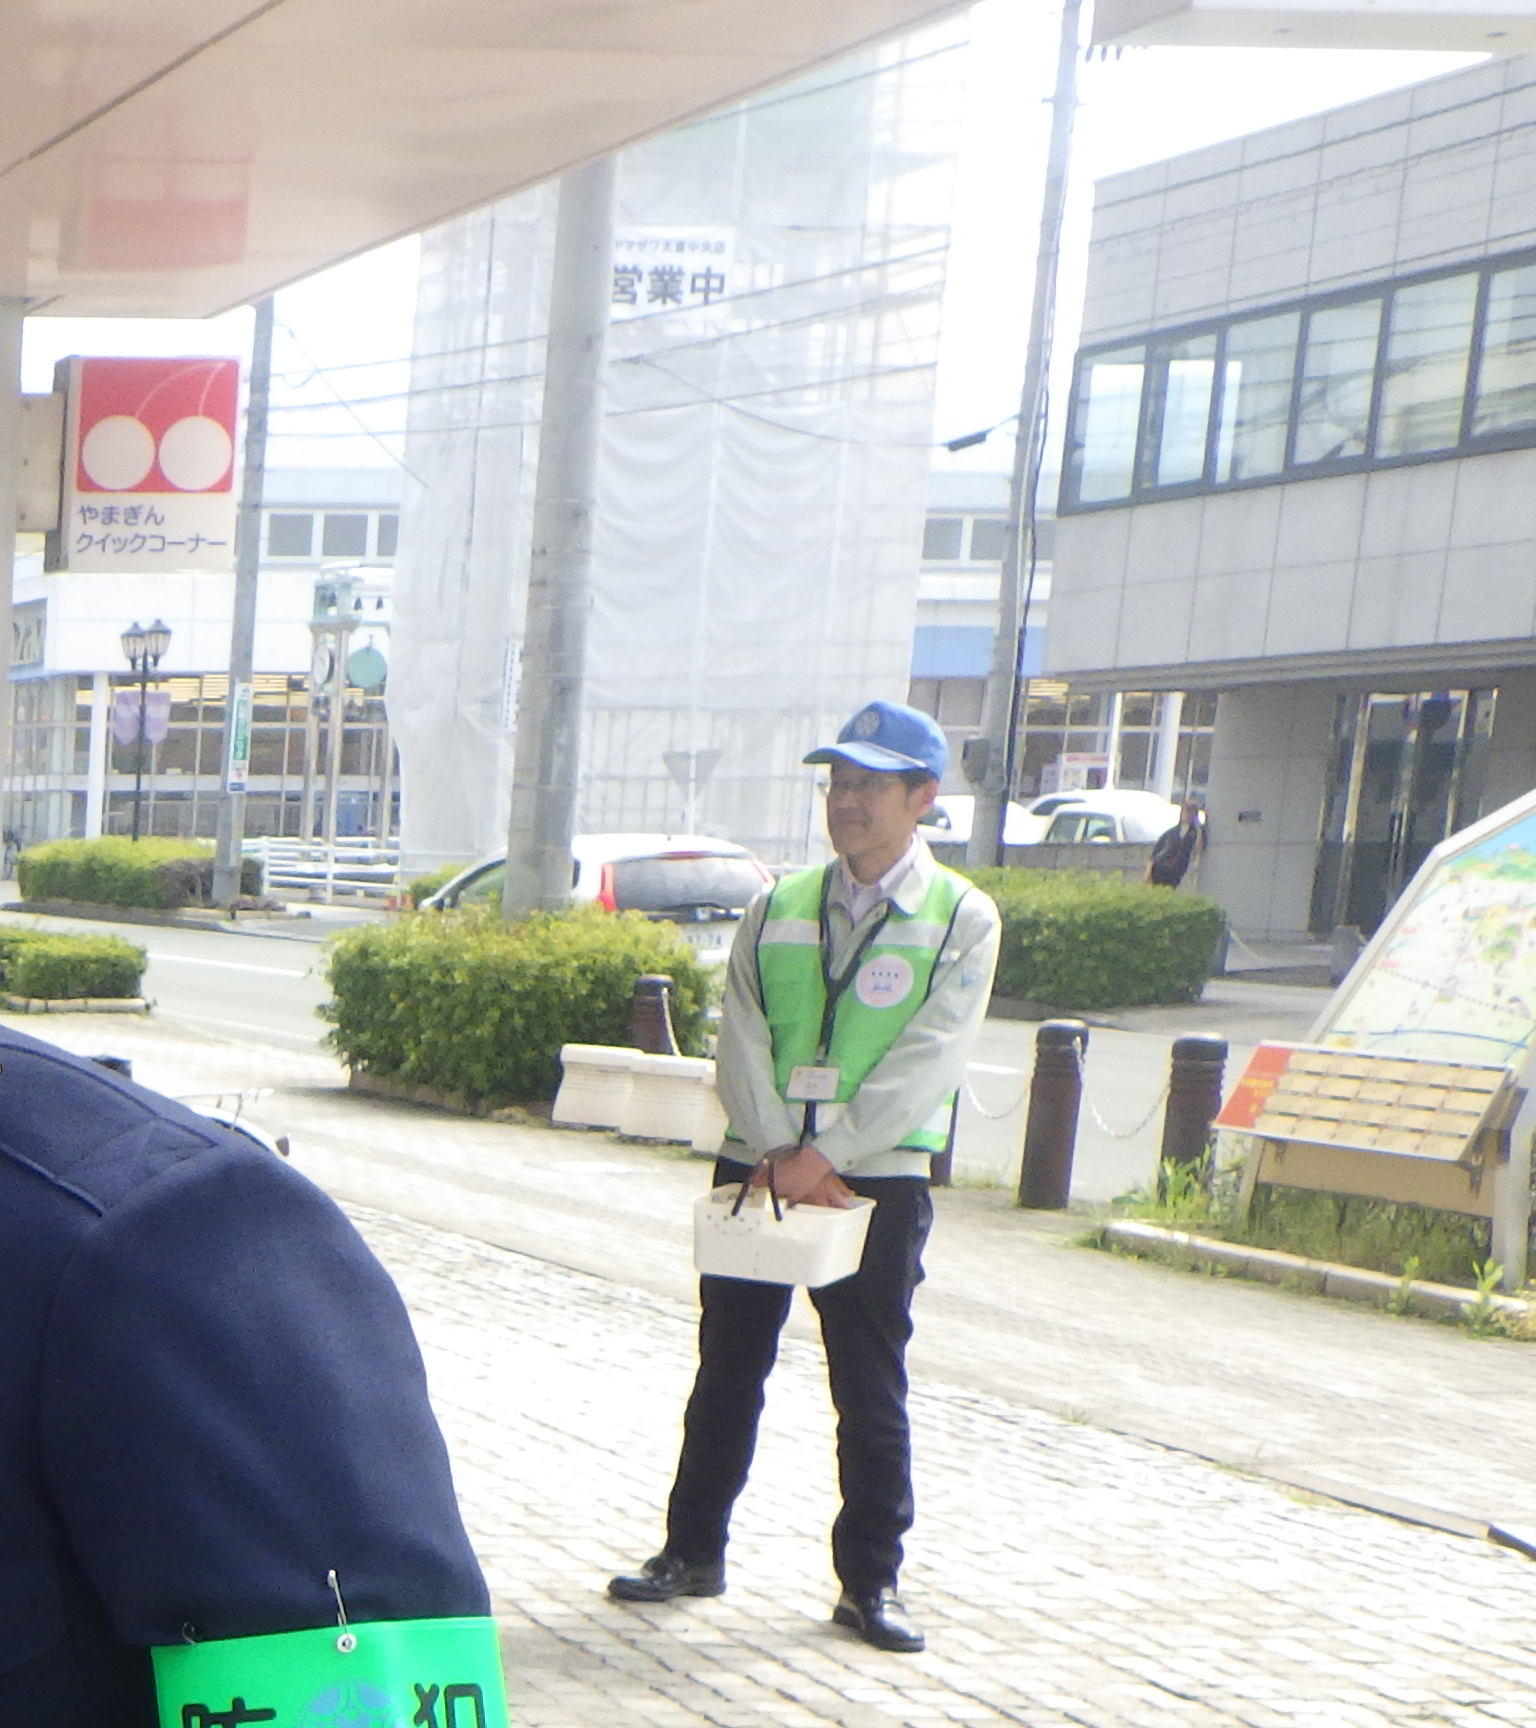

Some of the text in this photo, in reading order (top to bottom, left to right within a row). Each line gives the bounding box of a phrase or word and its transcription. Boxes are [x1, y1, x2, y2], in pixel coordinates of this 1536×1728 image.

[612, 263, 726, 305] 営業中
[79, 504, 166, 526] やまぎん
[76, 532, 228, 554] クイックコーナー
